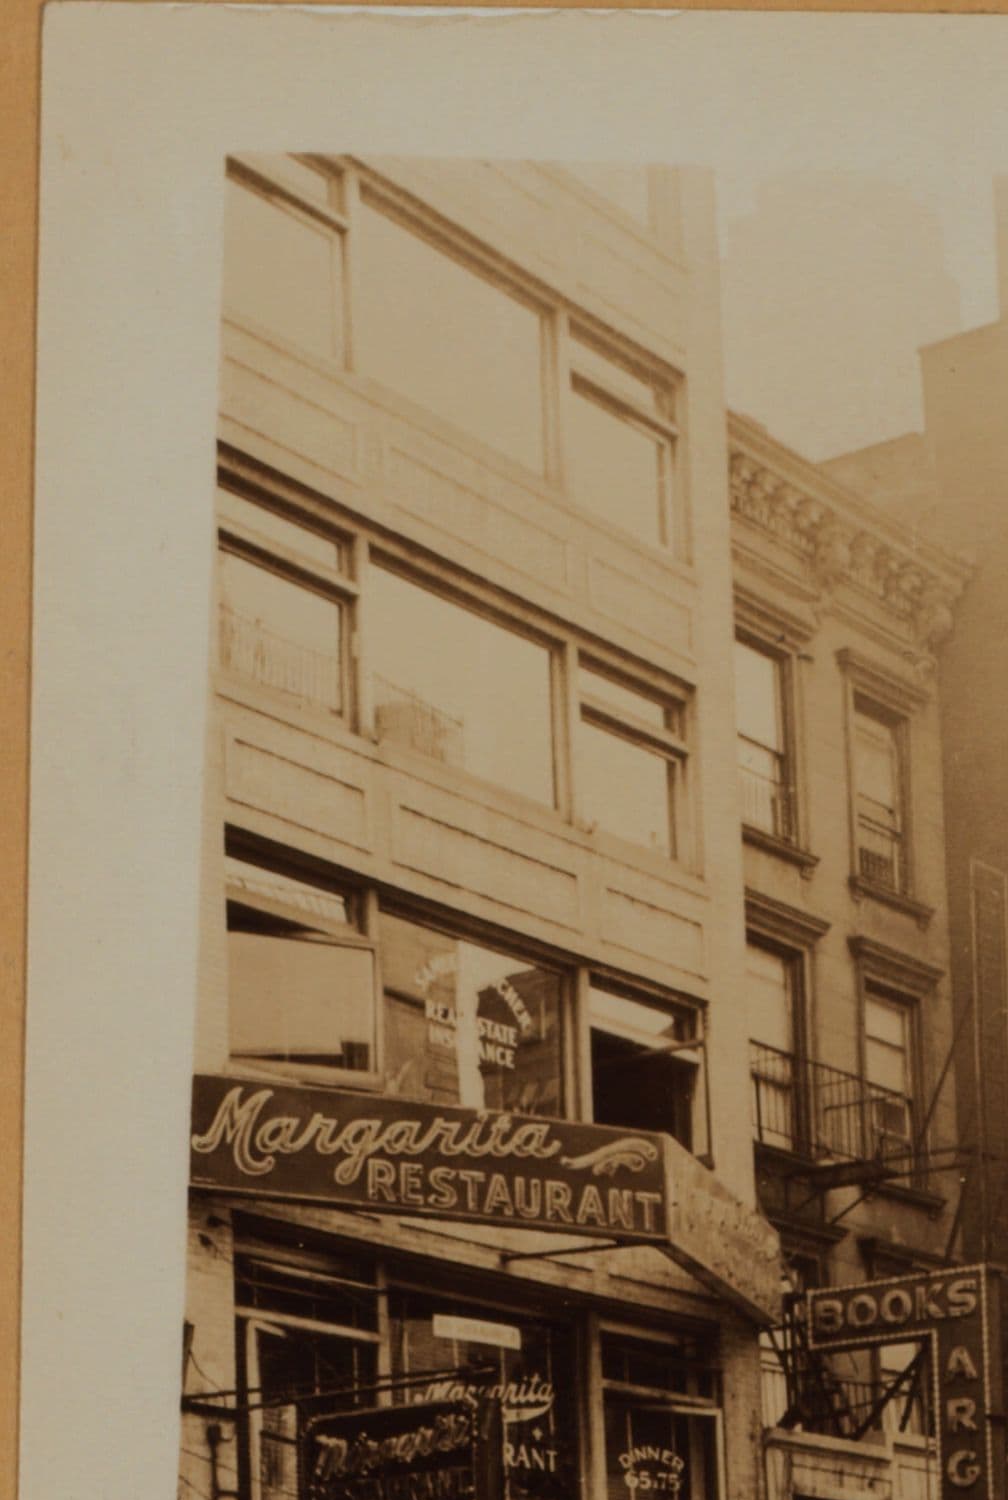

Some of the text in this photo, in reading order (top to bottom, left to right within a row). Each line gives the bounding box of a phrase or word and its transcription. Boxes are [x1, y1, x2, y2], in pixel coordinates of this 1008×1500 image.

[425, 999, 518, 1048] REA STATE
[429, 1022, 516, 1070] INSANCE
[191, 1086, 563, 1186] Margarita
[367, 1157, 661, 1231] RESTAURANT
[813, 1277, 978, 1332] BOOKS
[618, 1445, 685, 1473] DINNER
